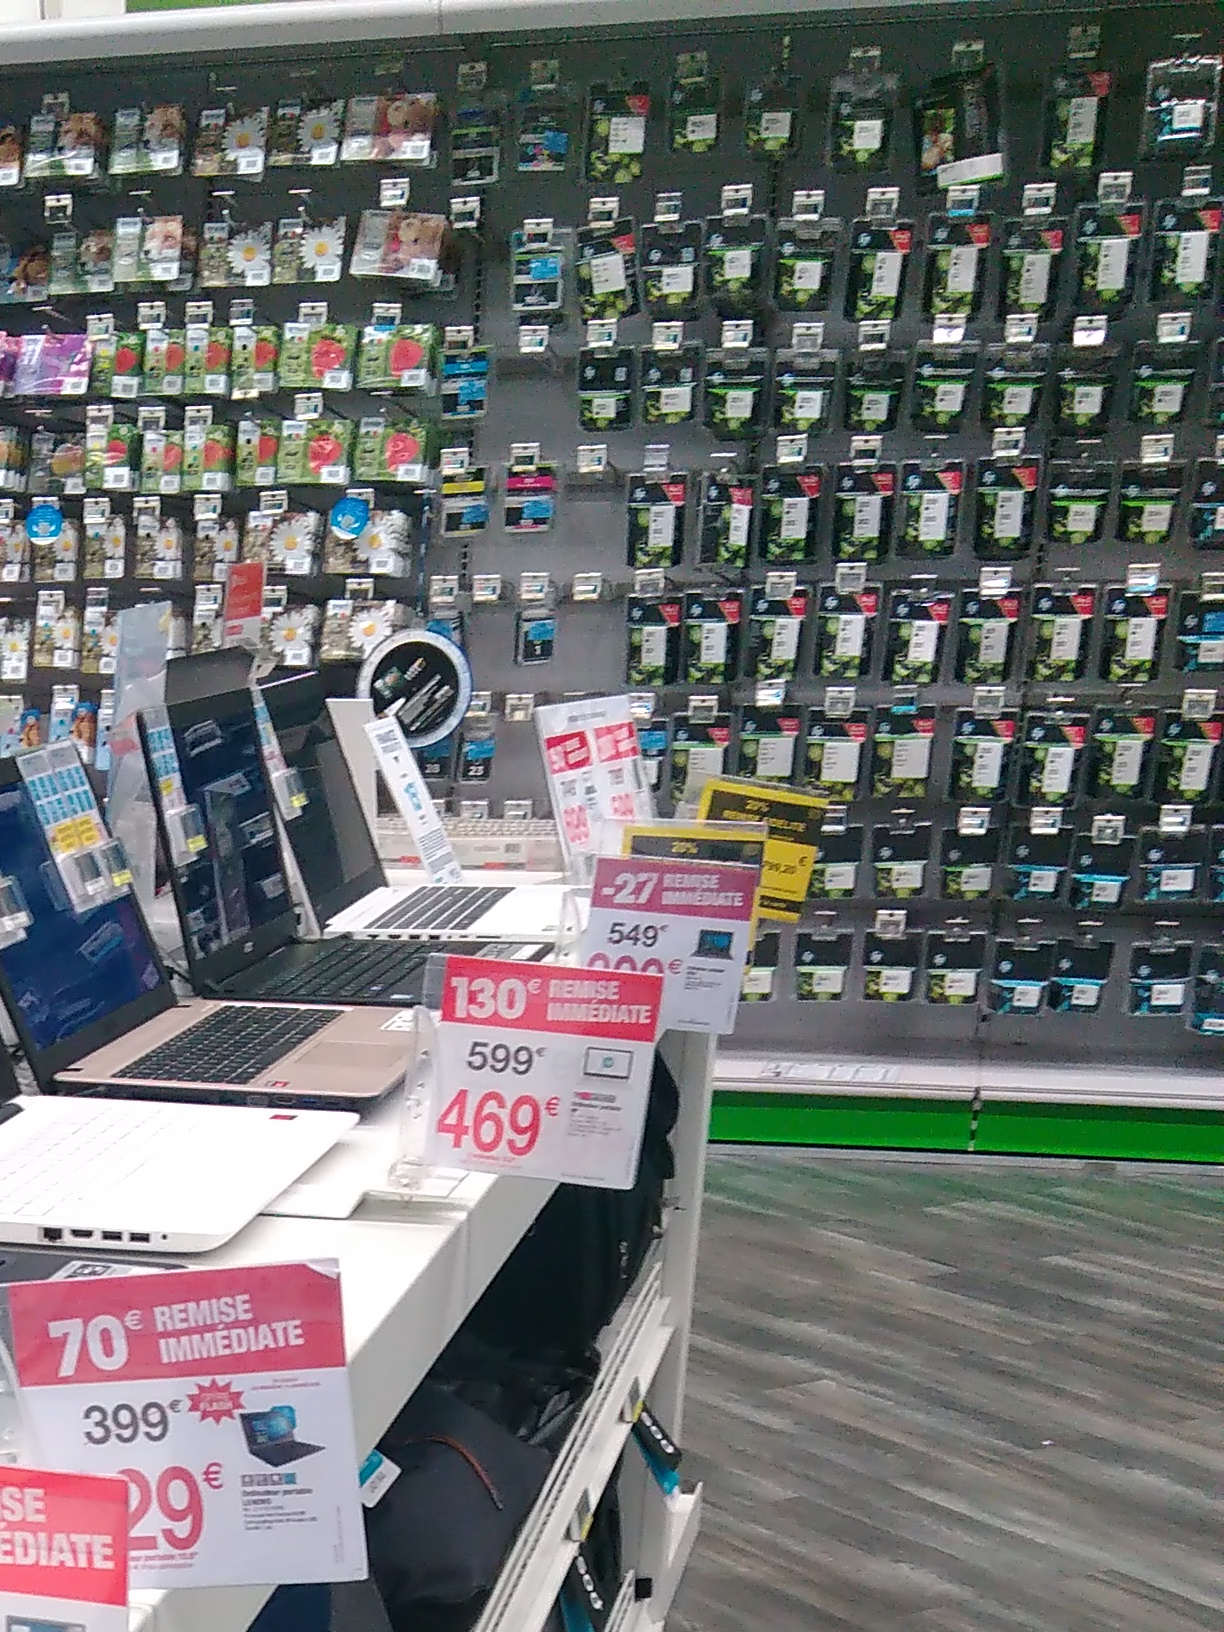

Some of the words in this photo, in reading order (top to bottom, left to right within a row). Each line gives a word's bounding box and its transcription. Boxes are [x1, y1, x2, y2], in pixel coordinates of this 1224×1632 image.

[660, 889, 745, 907] IMMÉDIATE
[663, 873, 721, 890] REMISE
[450, 976, 543, 1021] 130€
[548, 979, 620, 1000] REMISE
[546, 999, 653, 1025] IMMÉDIATE
[436, 1088, 562, 1157] 469€
[153, 1293, 253, 1333] REMISE
[47, 1309, 144, 1379] 70€
[157, 1319, 306, 1365] IMMÉDIATE
[82, 1398, 184, 1446] 399€
